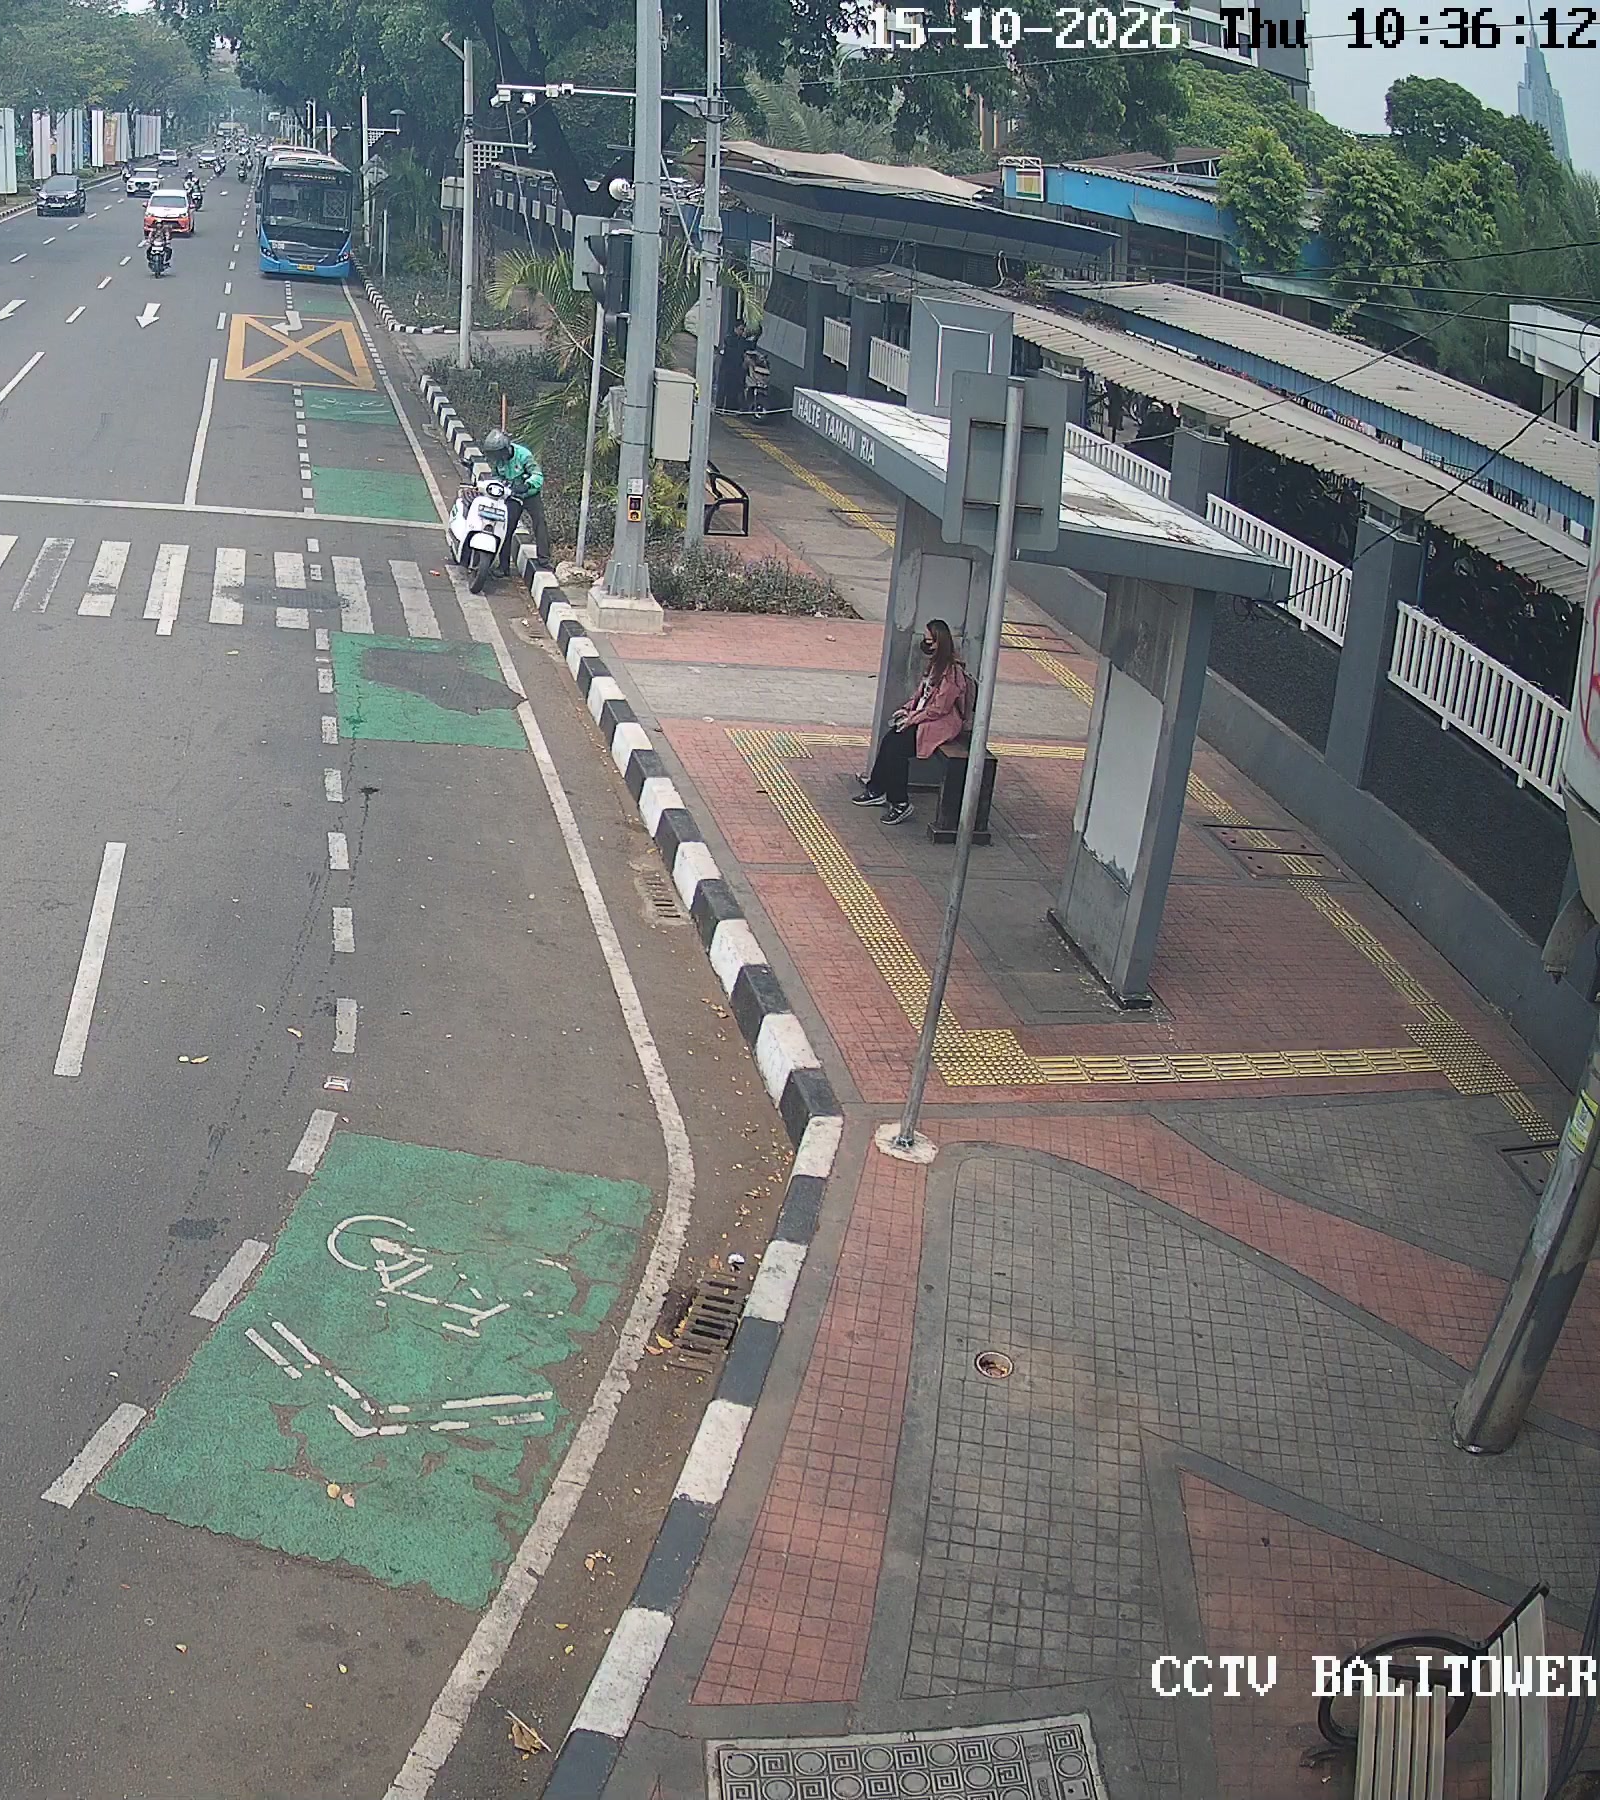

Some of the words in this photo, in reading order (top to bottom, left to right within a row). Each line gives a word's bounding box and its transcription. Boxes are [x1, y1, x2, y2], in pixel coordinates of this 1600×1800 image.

[797, 395, 821, 429] HALTE
[825, 412, 856, 452] TAMAN
[860, 436, 875, 466] RIA
